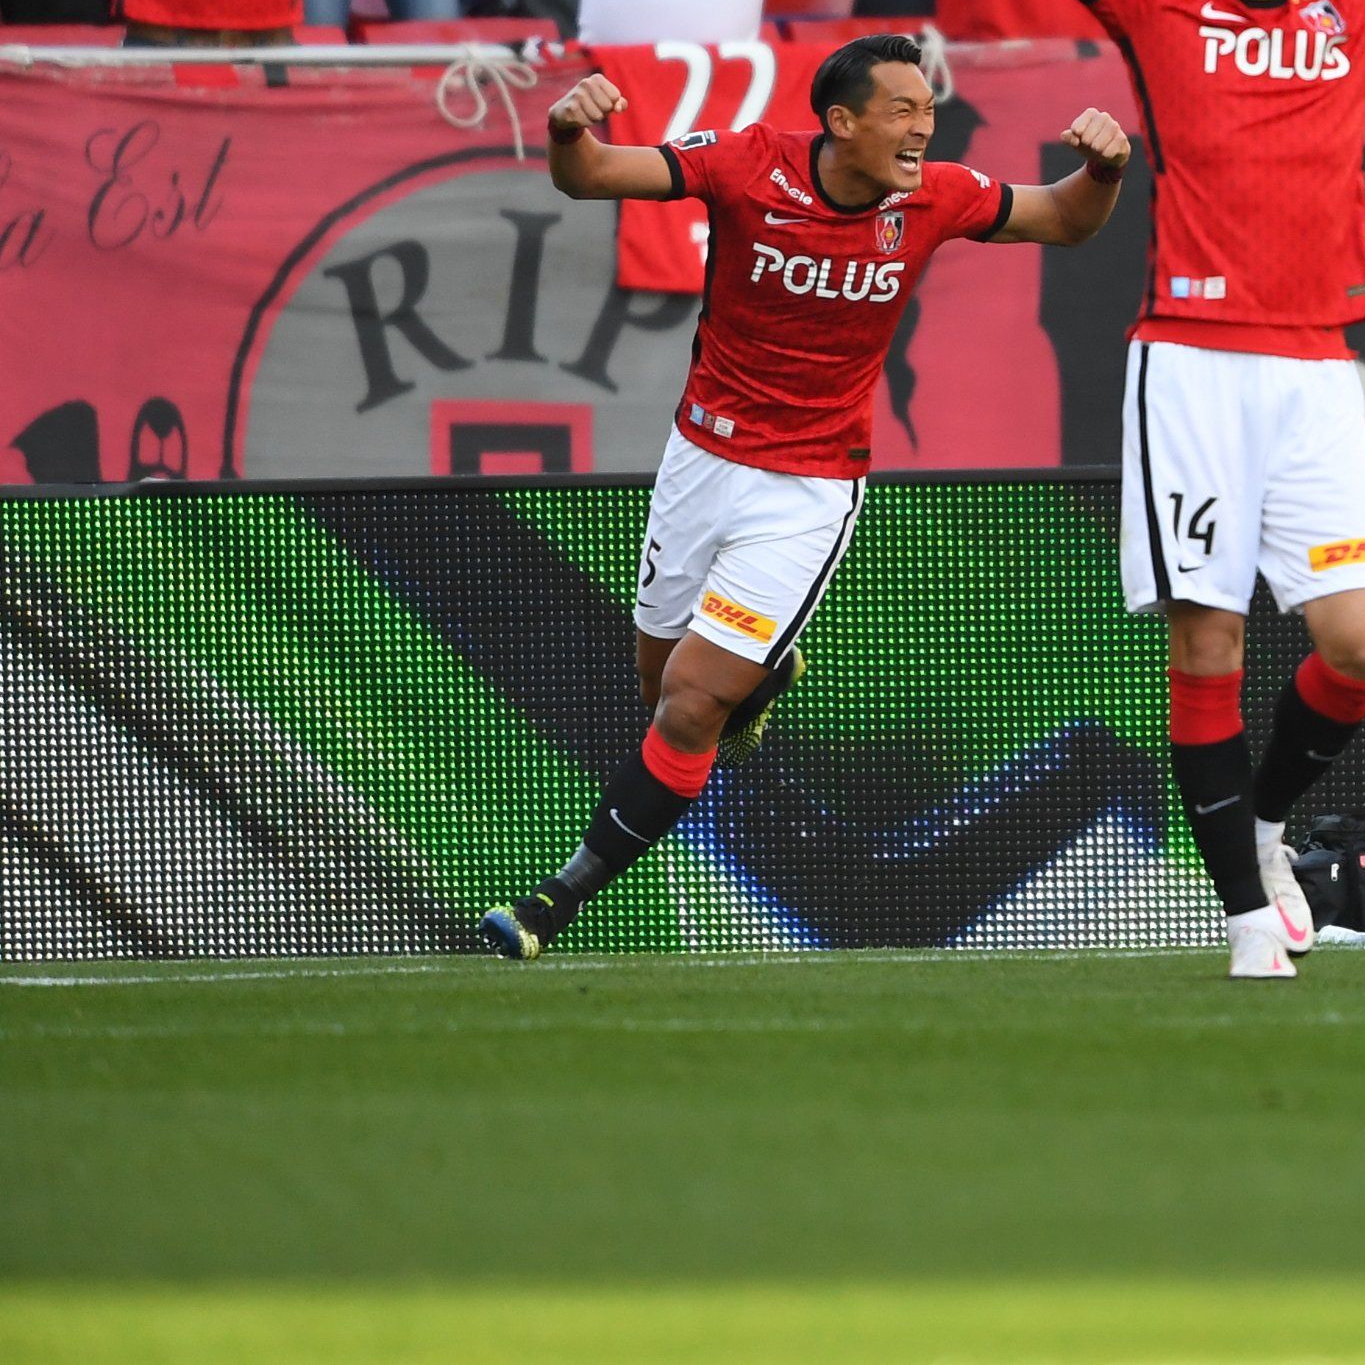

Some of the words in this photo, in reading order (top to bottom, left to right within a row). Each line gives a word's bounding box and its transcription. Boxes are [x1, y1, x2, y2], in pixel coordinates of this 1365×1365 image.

[1199, 25, 1351, 81] POLUS
[751, 242, 905, 303] POLUS
[1169, 492, 1218, 556] 14
[641, 536, 662, 589] 5
[702, 596, 760, 635] DHL
